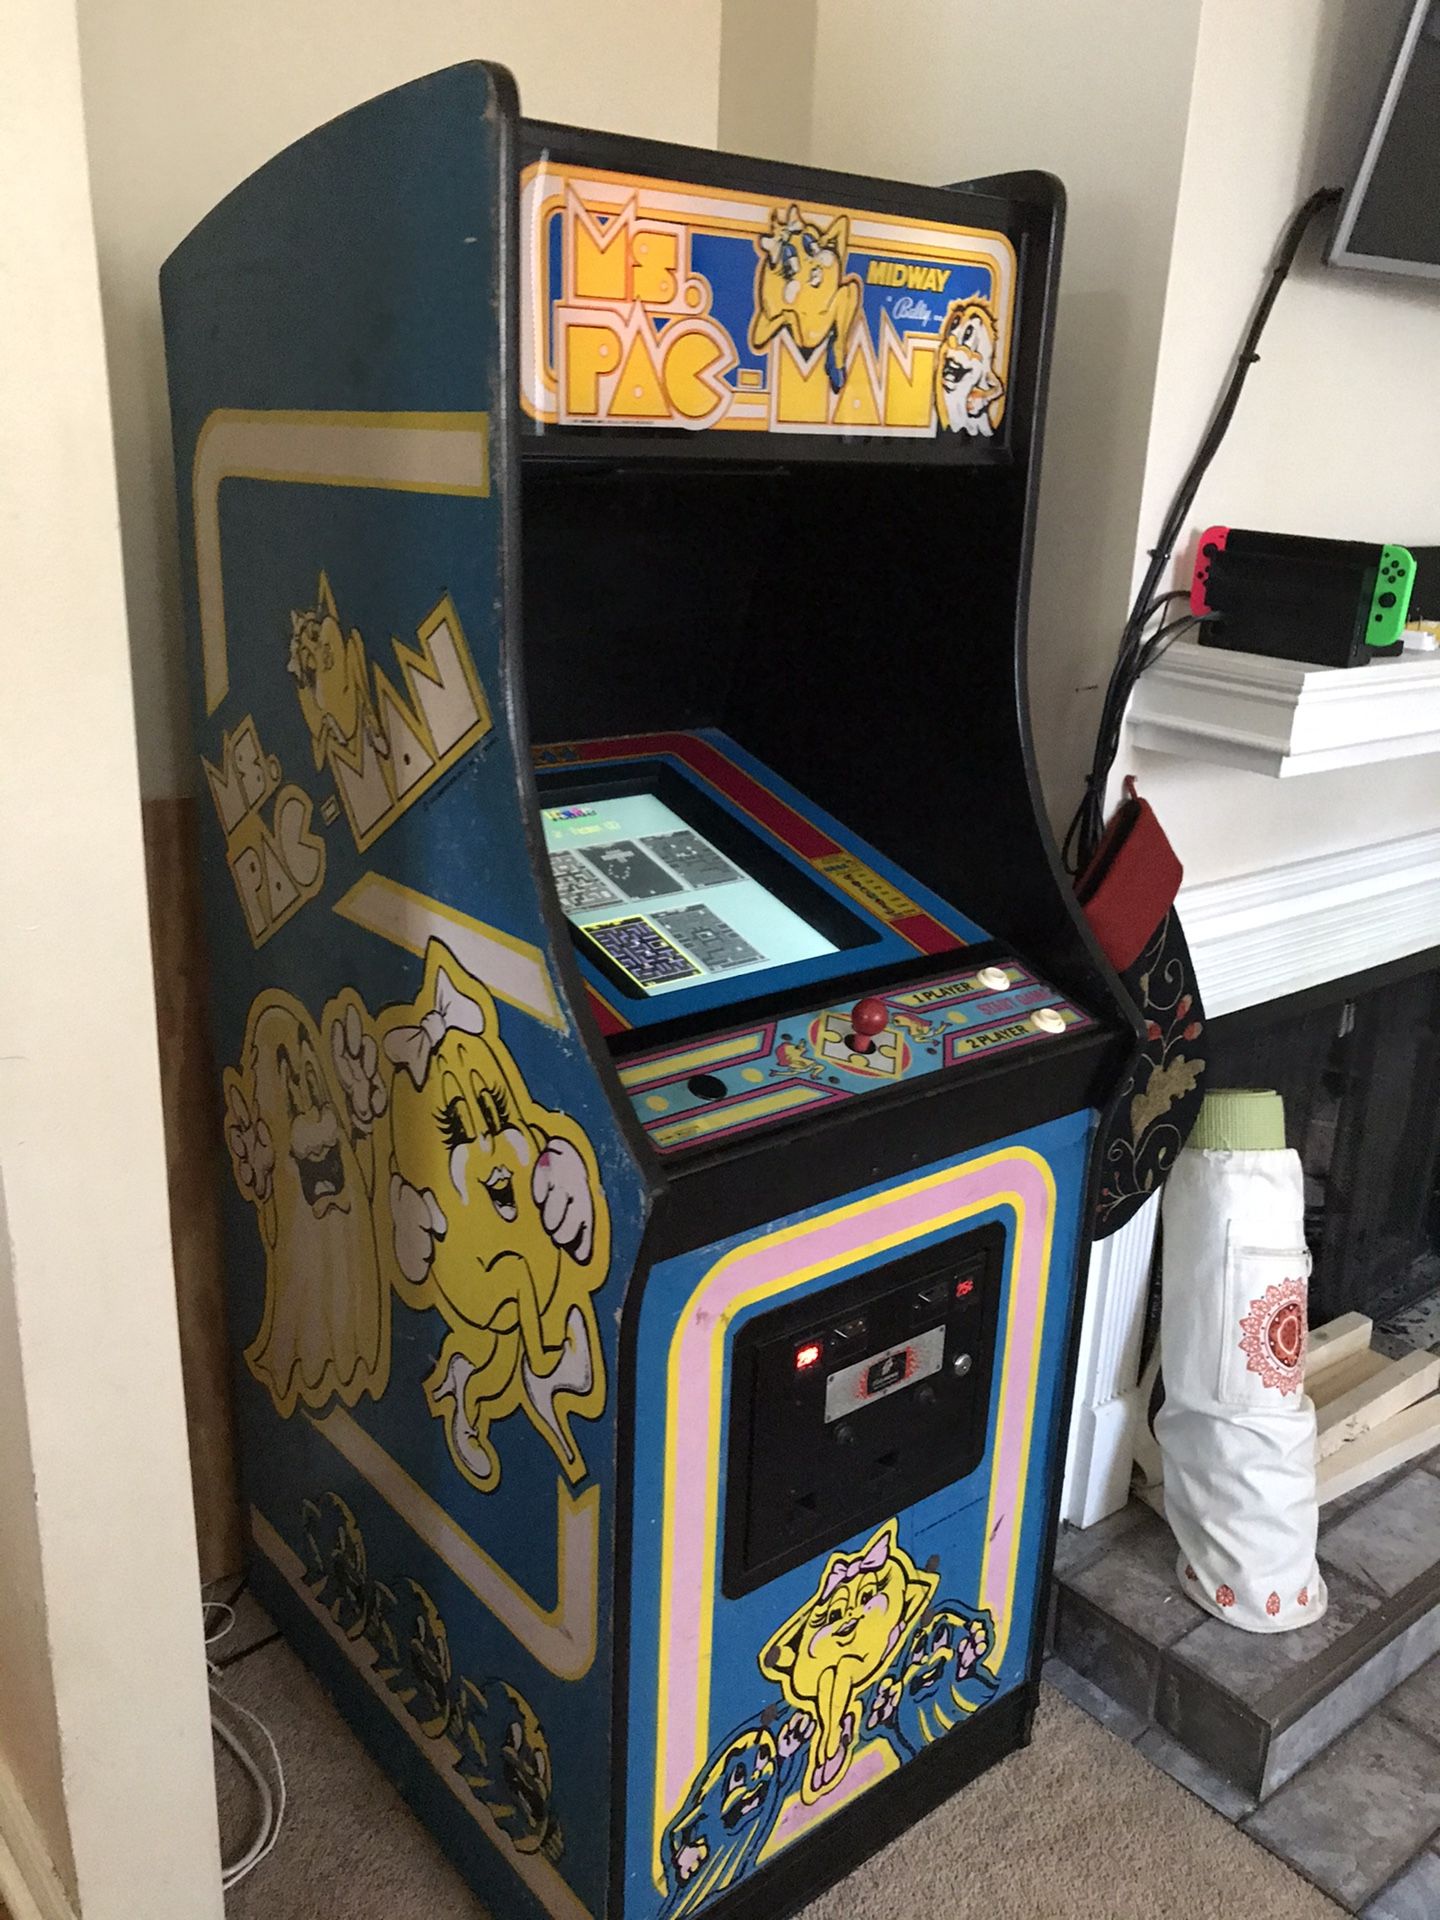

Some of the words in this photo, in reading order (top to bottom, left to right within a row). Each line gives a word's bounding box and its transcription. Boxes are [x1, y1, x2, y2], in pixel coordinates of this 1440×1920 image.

[866, 260, 952, 293] MIDWAY
[892, 297, 932, 327] Bally
[555, 297, 938, 437] PAC-MAN
[226, 589, 494, 950] PAC-MAN
[912, 993, 924, 1003] 1
[922, 981, 975, 1001] PLAYER
[976, 997, 1016, 1016] START
[965, 1038, 980, 1049] 2
[976, 1025, 1029, 1046] PLAYER
